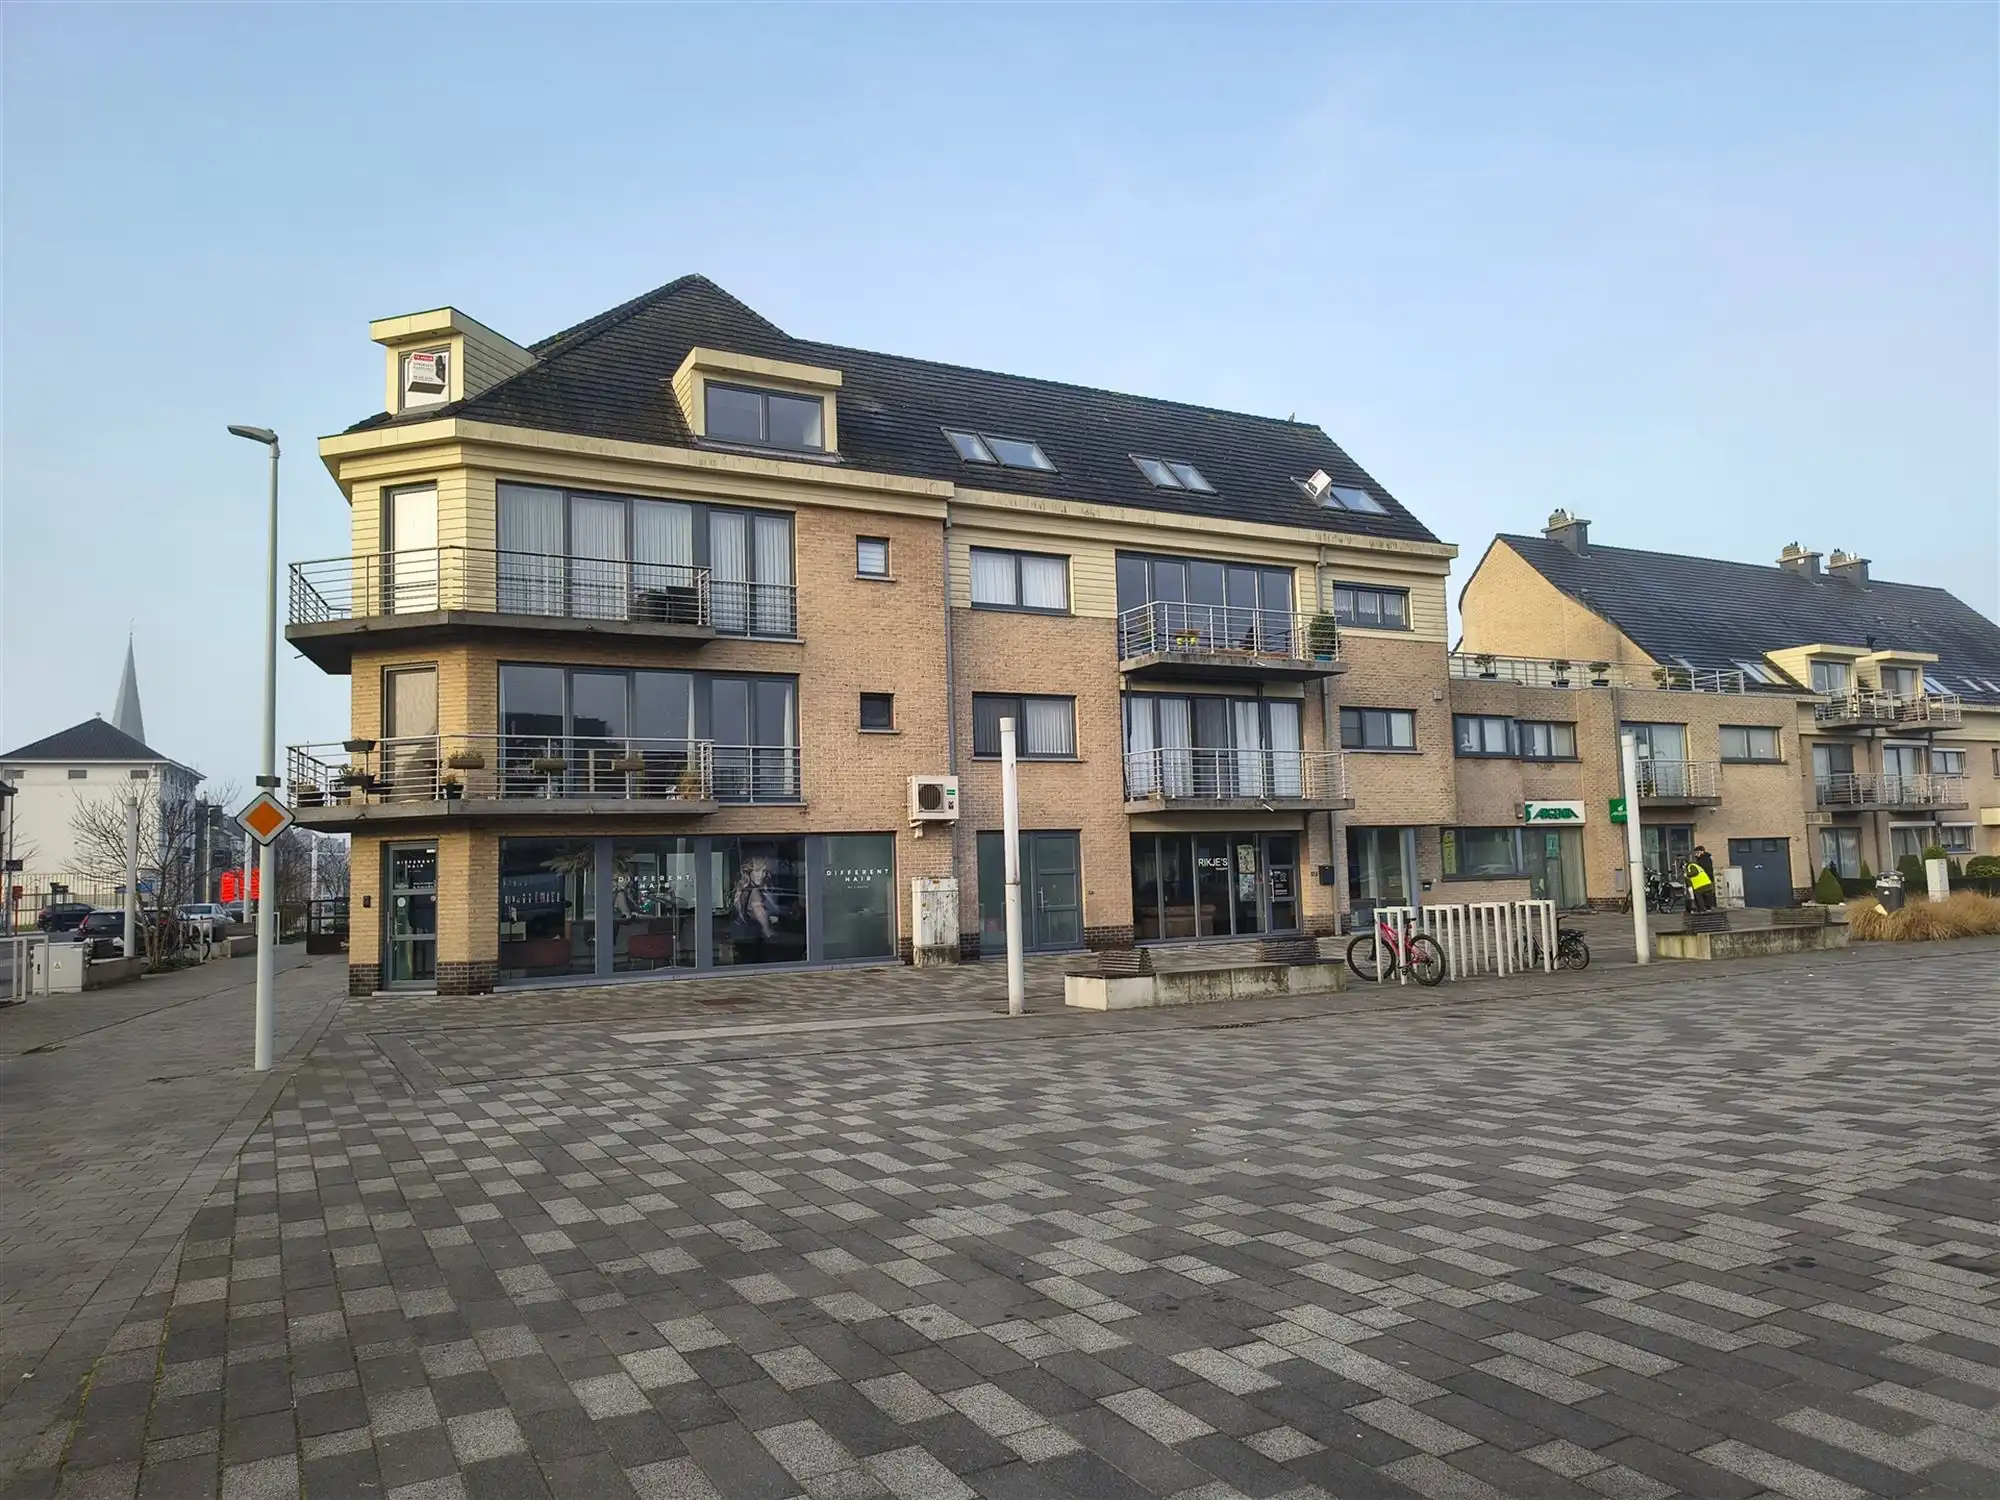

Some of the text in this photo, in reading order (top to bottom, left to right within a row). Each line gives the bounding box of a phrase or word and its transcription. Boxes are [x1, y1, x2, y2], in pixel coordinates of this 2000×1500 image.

[1198, 857, 1228, 867] RIKJE'S
[825, 868, 889, 876] DIFFERENT
[618, 874, 691, 882] DIFFERENT
